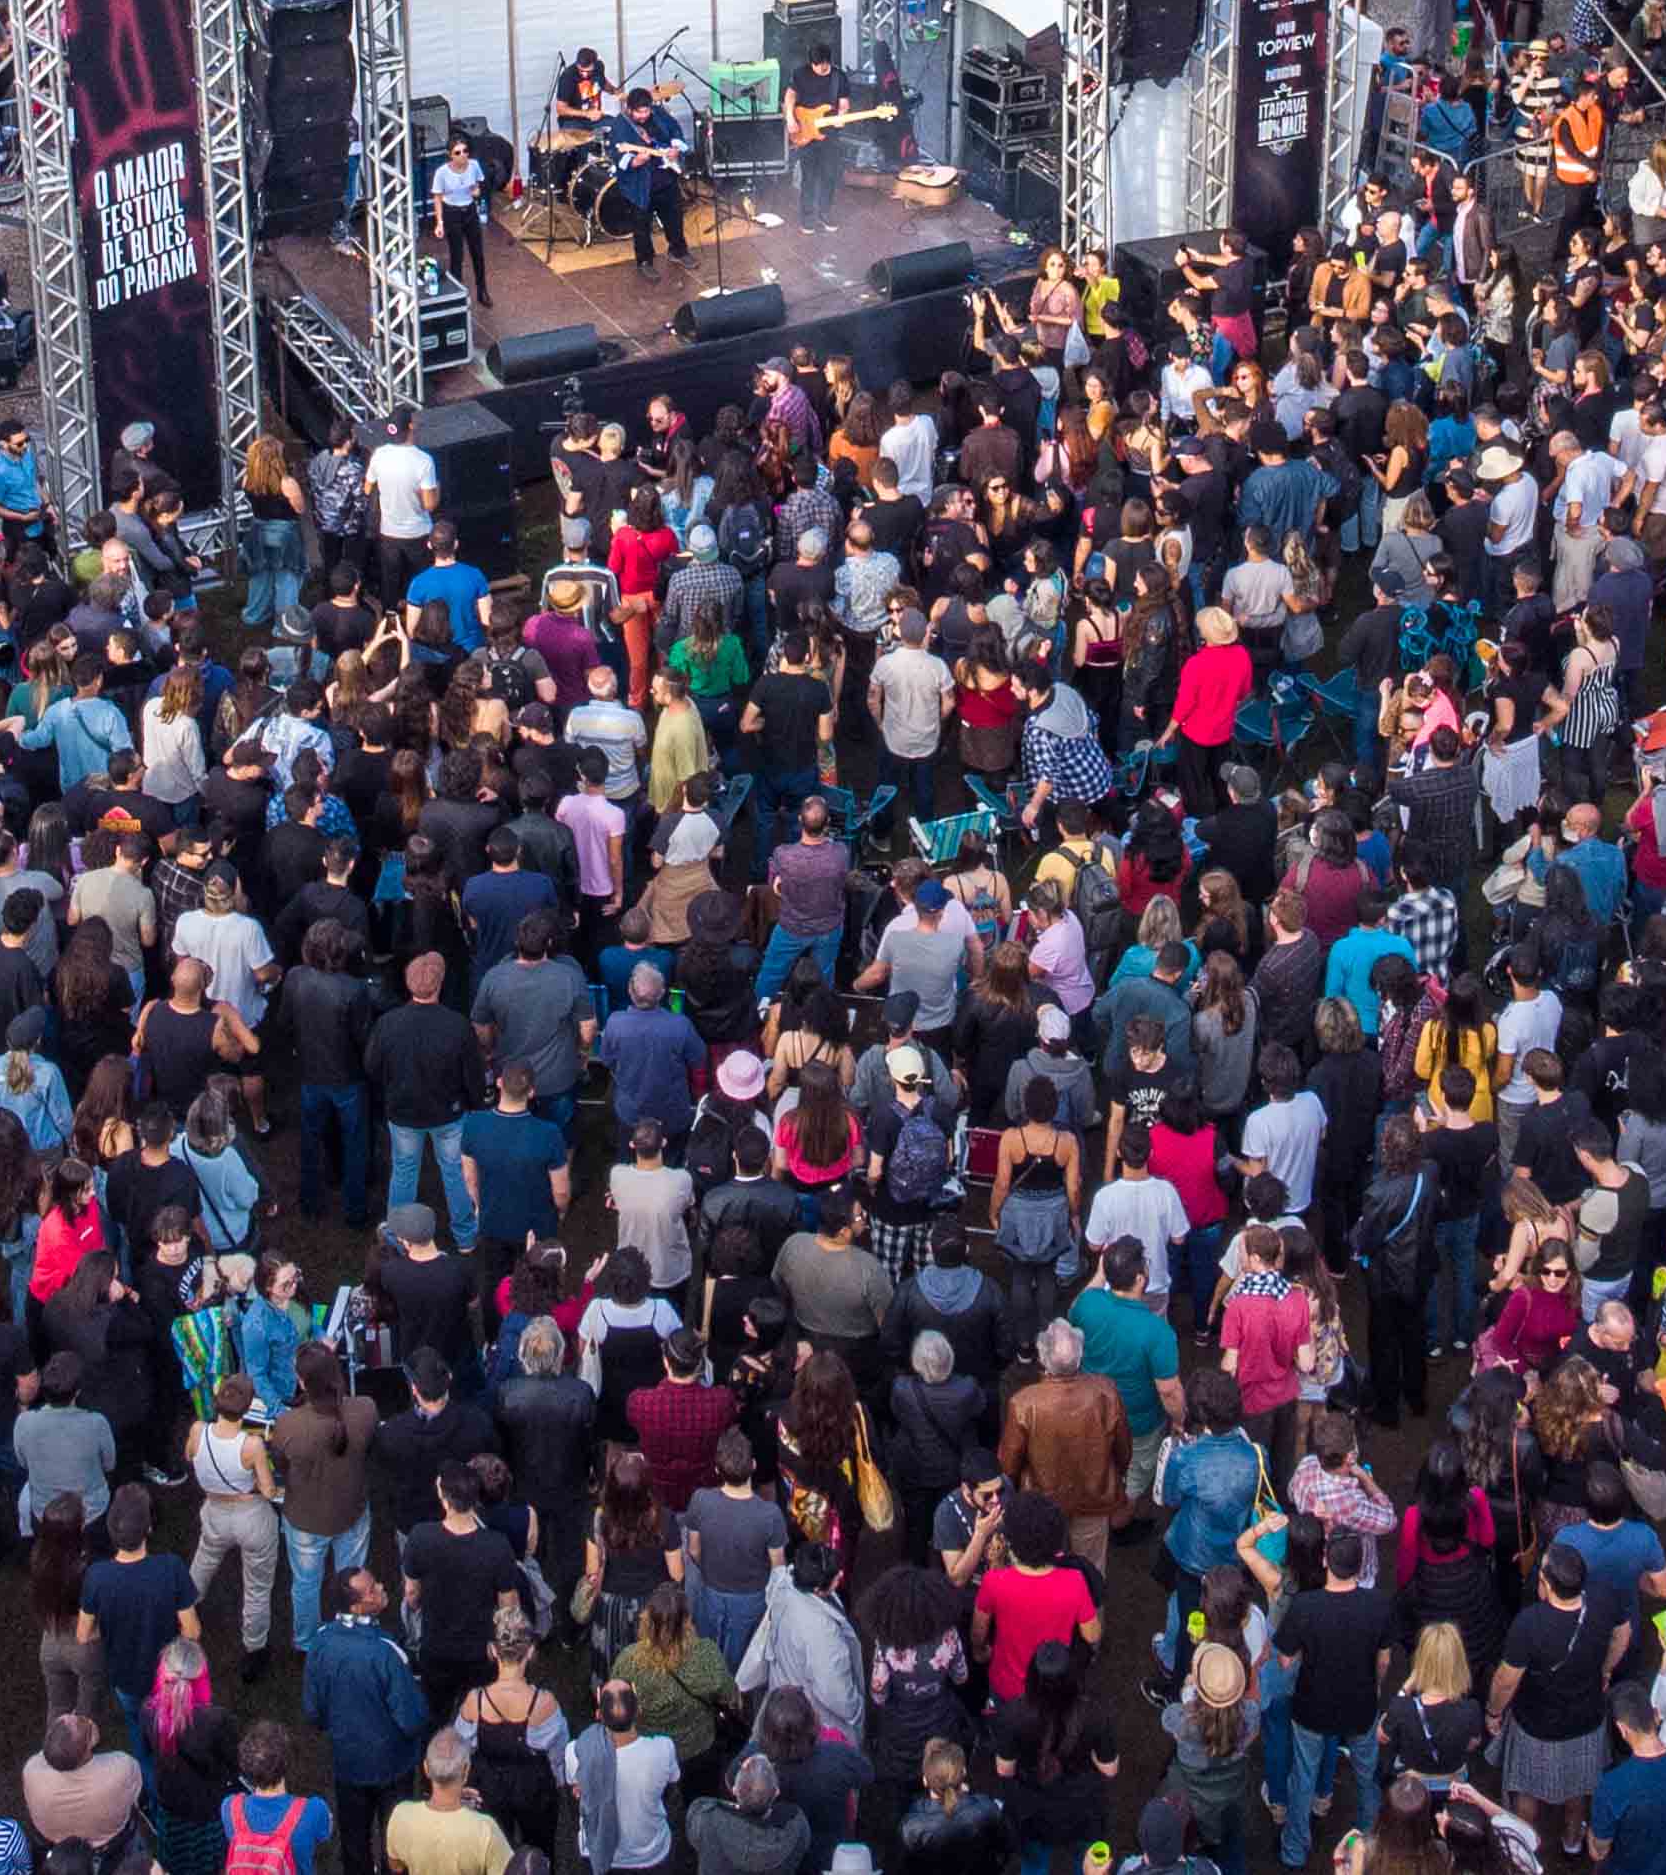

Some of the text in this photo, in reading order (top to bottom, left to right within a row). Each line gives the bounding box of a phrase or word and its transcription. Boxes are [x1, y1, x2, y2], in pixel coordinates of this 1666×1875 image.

[1257, 33, 1316, 57] TOPVIEW
[1258, 98, 1308, 120] ITAIPAVA
[94, 142, 186, 210] O MAIOR
[100, 182, 184, 241] FESTIVAL
[96, 237, 198, 311] DO PARANÁ
[102, 214, 187, 275] DE BLUES
